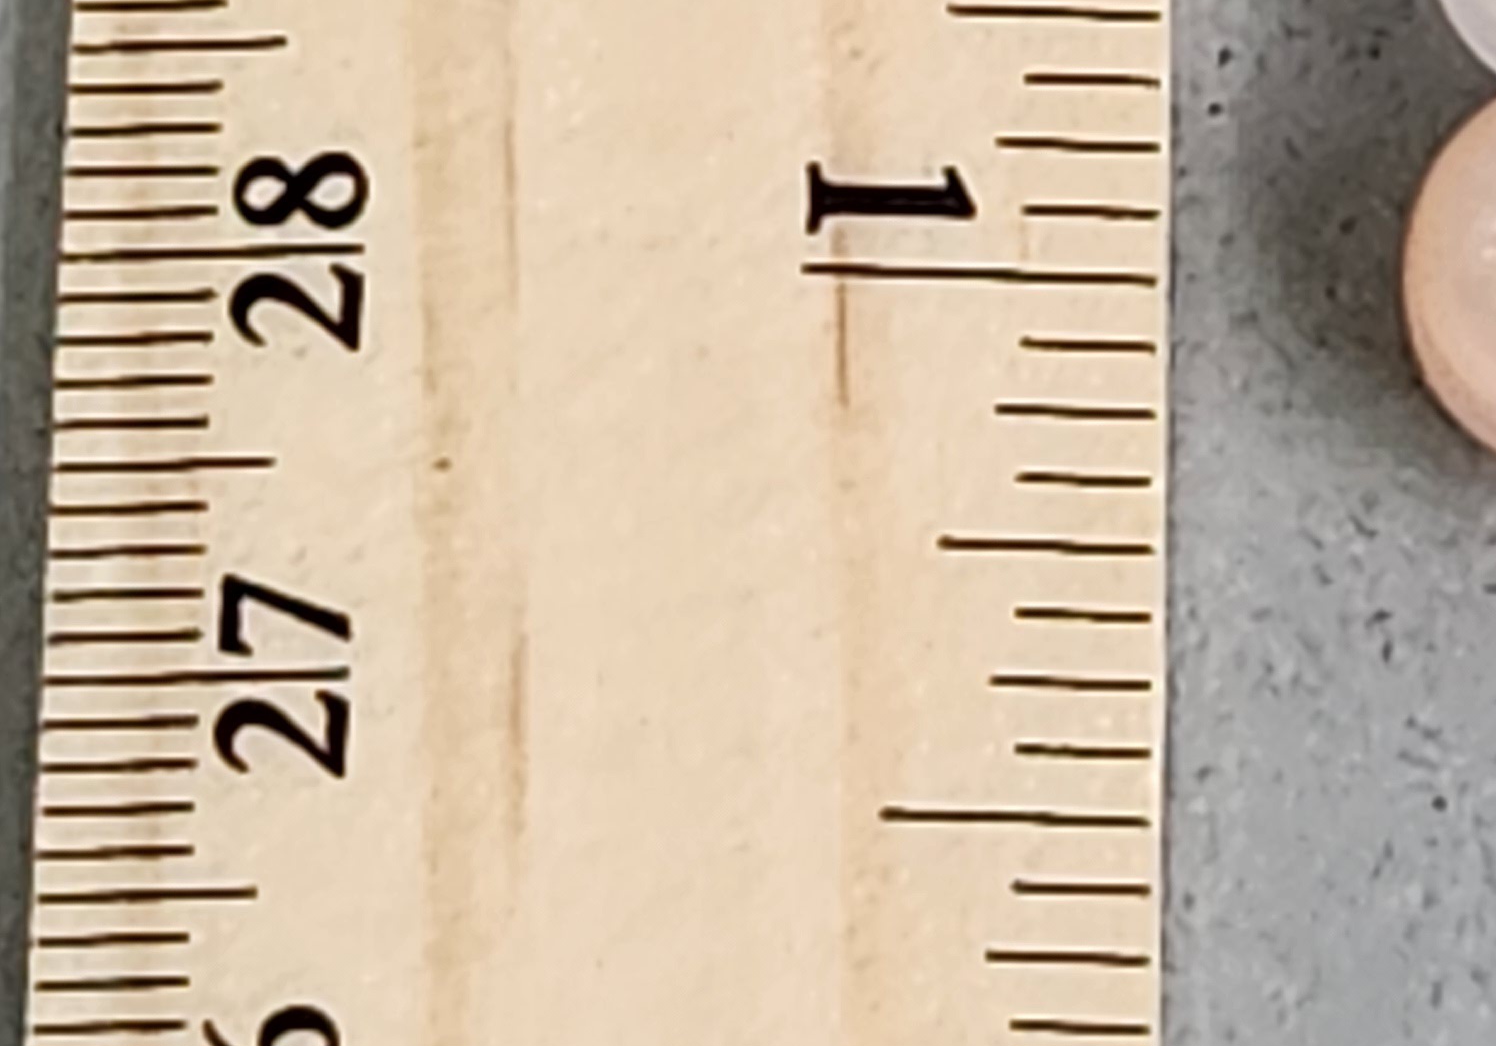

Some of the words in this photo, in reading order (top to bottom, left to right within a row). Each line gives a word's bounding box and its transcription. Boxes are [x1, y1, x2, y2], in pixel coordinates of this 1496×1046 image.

[230, 151, 370, 350] 28
[805, 161, 976, 233] 1
[214, 573, 352, 777] 27
